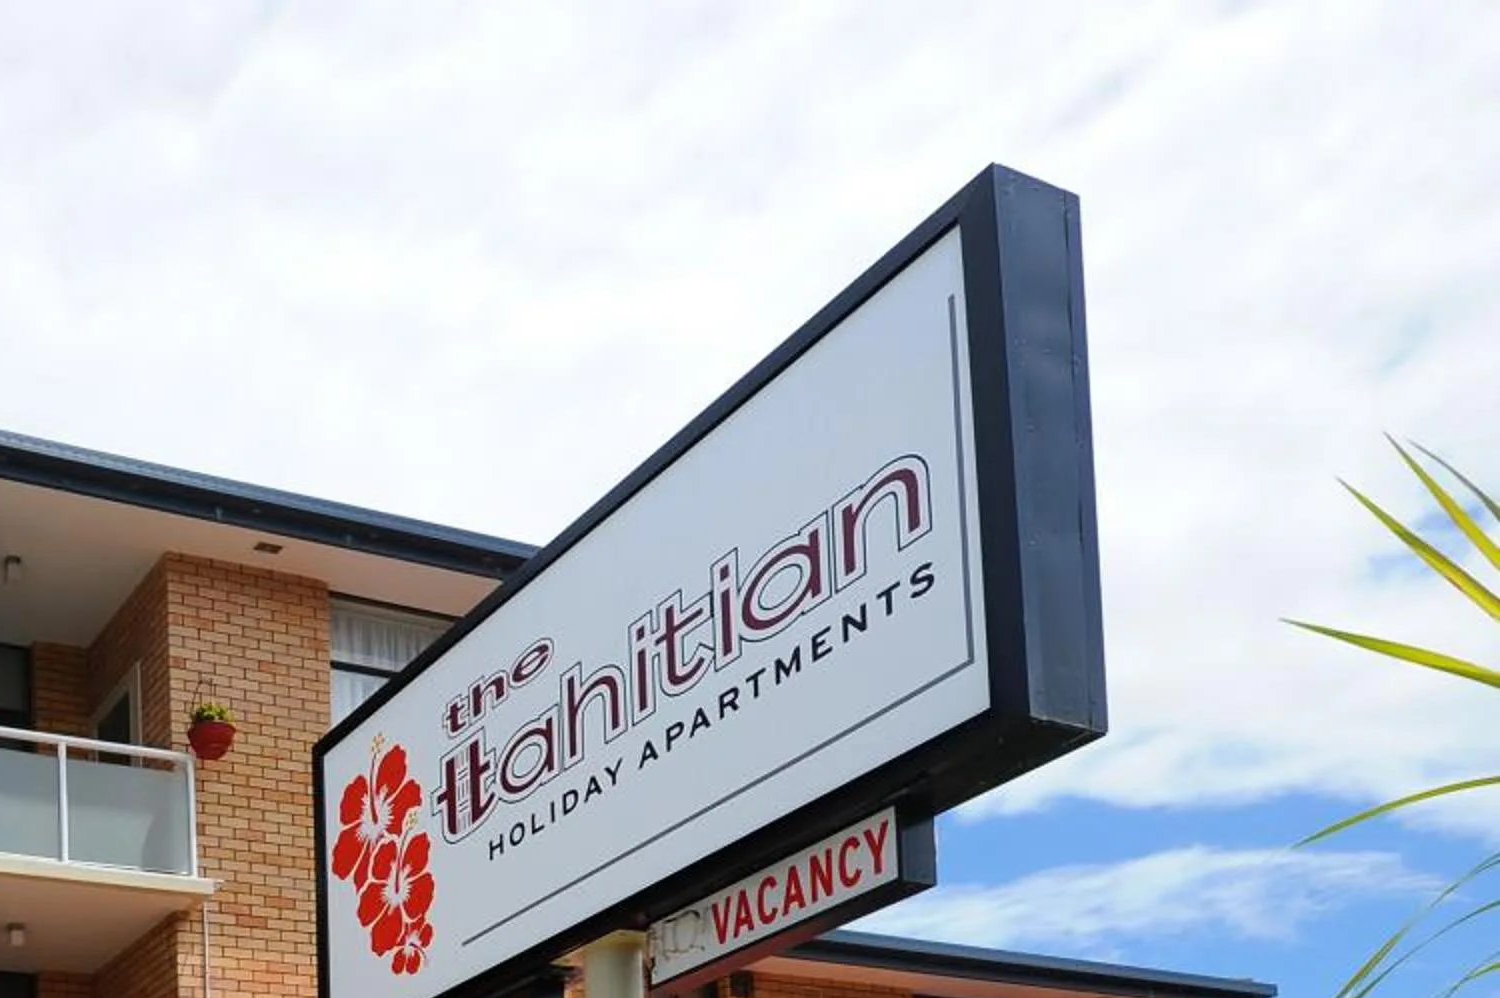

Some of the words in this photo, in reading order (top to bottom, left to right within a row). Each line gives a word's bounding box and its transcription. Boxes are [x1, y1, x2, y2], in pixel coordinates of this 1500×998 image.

[489, 757, 624, 860] HOLIDAY
[638, 561, 936, 770] APARTMENTS
[711, 818, 890, 945] VACANCY
